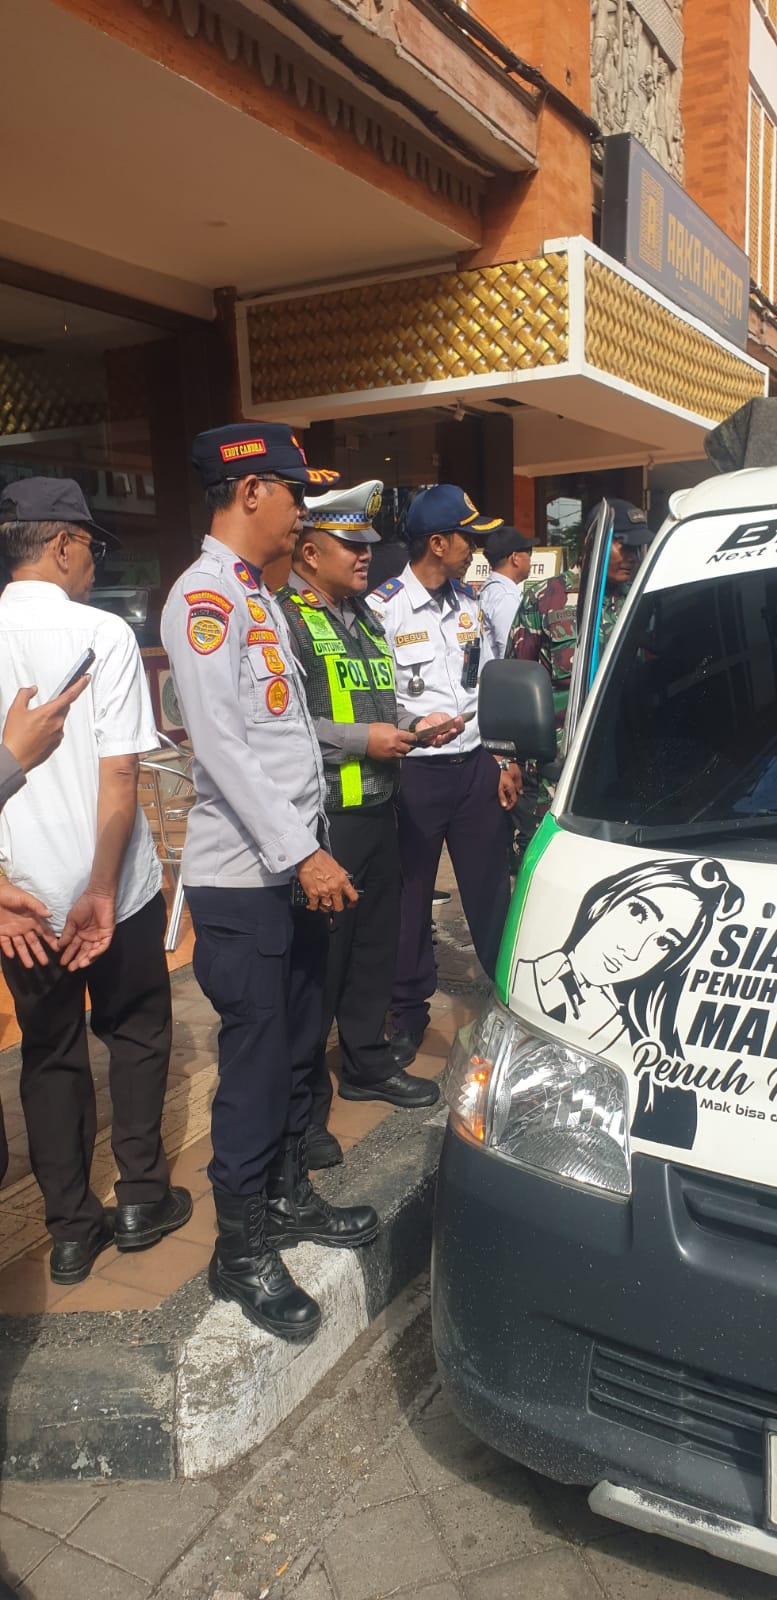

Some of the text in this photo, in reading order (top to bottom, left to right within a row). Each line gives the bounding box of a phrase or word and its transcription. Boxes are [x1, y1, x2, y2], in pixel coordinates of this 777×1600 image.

[667, 214, 701, 287] ARKA
[702, 245, 744, 321] AMERTA
[706, 547, 767, 564] Next
[335, 660, 393, 688] POLISI
[689, 969, 777, 1003] PENUH
[685, 1000, 777, 1060] MA
[634, 1041, 754, 1096] Penuh
[699, 1098, 732, 1113] Mak
[735, 1104, 766, 1120] bisa
